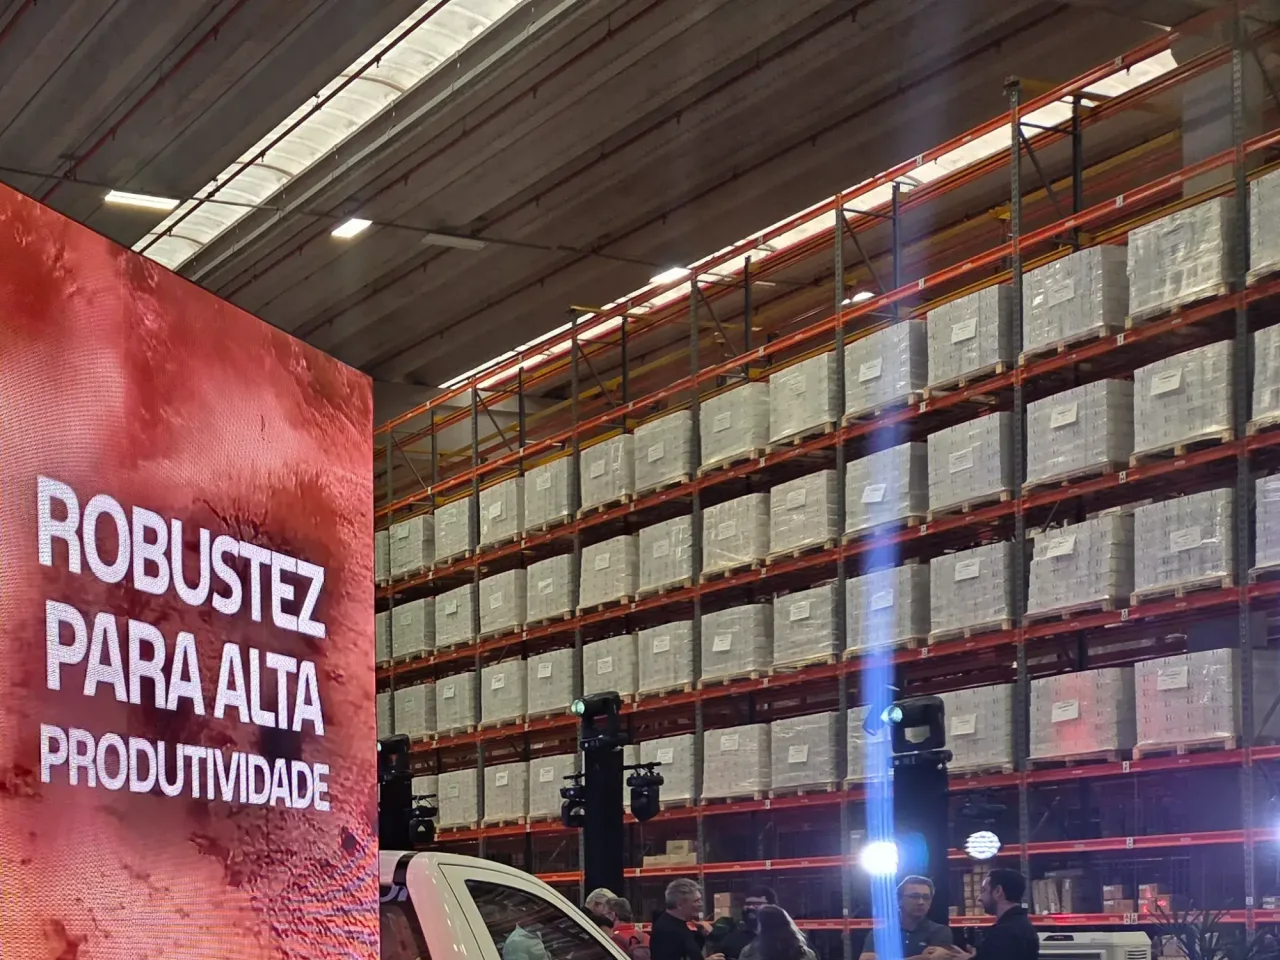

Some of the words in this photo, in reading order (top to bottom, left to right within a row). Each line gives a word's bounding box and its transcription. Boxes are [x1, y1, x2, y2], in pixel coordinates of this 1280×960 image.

[37, 474, 326, 639] ROBUSTEZ
[45, 600, 205, 715] PARA
[214, 642, 325, 737] ALTA
[40, 723, 331, 811] PRODUTIVIDADE
